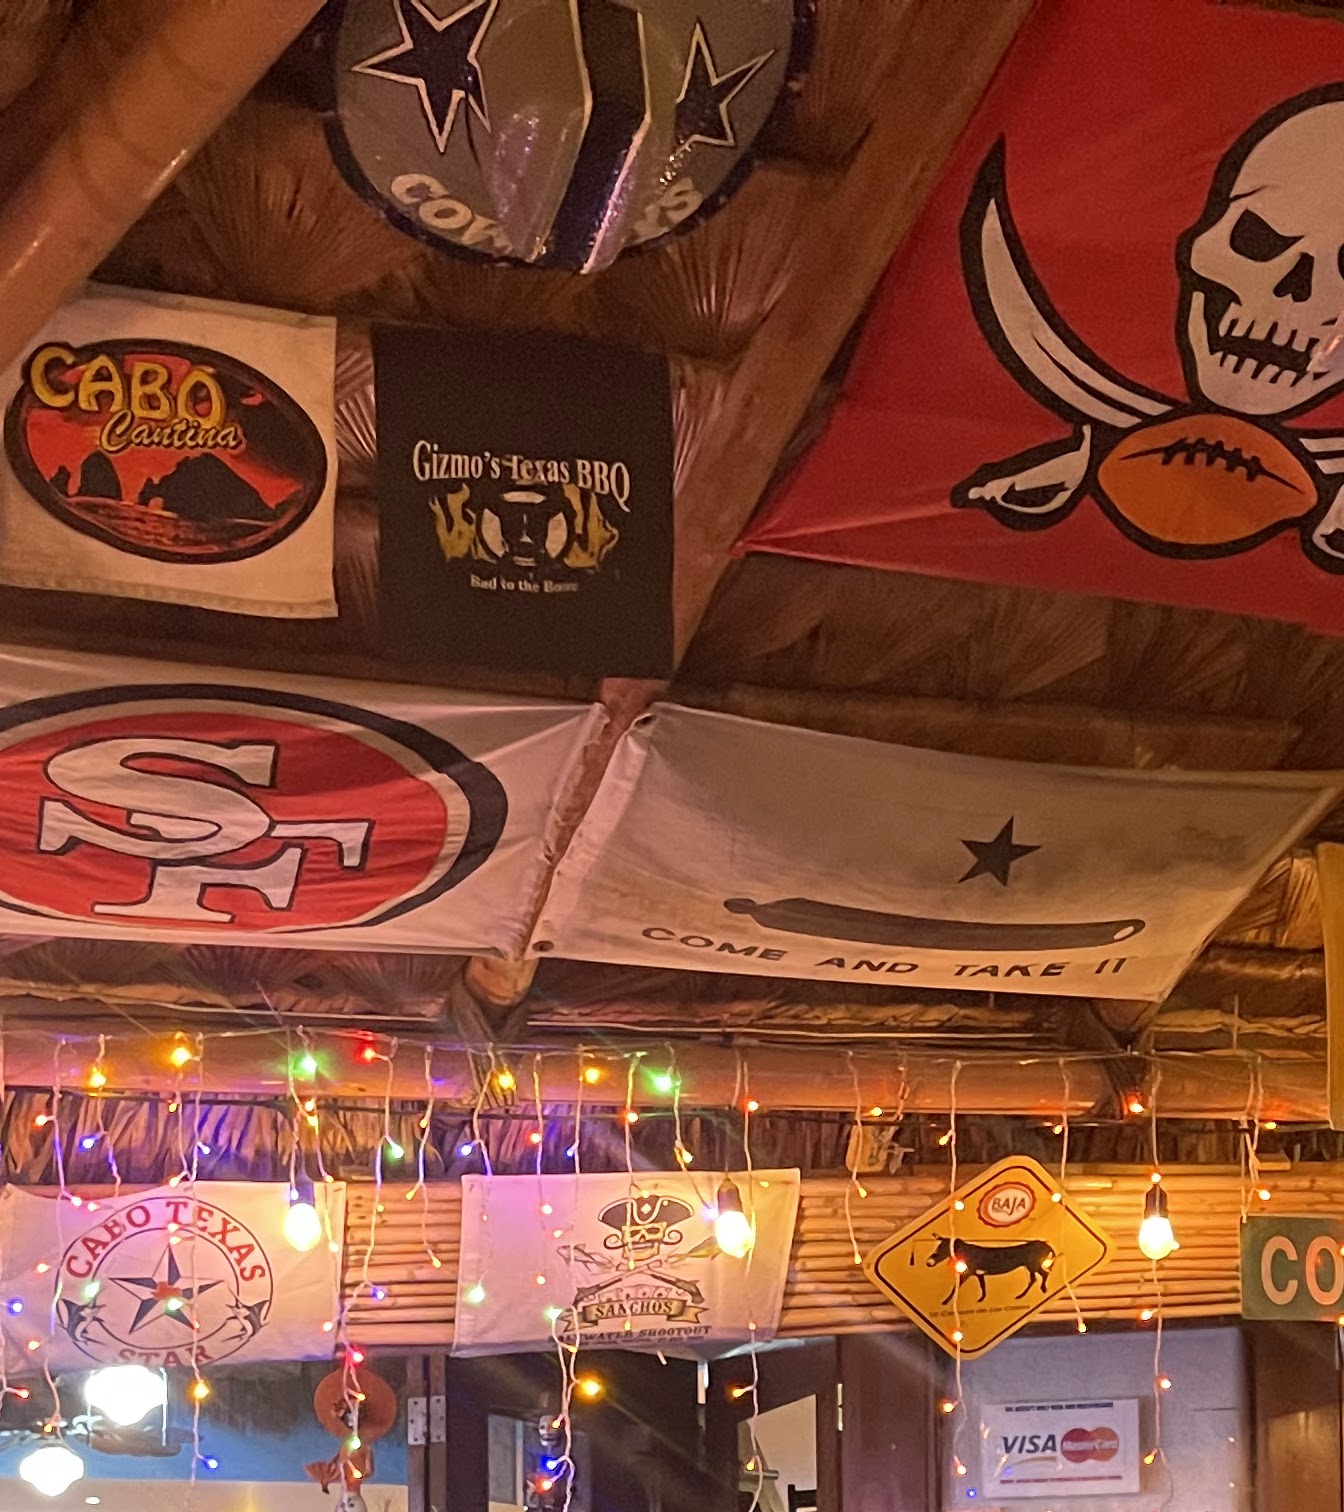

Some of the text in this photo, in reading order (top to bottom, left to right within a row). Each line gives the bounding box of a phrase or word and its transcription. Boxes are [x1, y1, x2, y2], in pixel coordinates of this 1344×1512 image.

[30, 345, 227, 429] CABO
[100, 408, 243, 454] Cantina
[413, 440, 631, 513] Gizmo's Texas BBQ
[470, 573, 497, 590] Bad
[518, 575, 540, 592] the
[641, 926, 1133, 980] COME AND TAKE IT
[991, 1197, 1027, 1216] BAJA
[65, 1200, 267, 1283] CABO TEXAS
[594, 1300, 674, 1320] SANCHOS
[638, 1325, 713, 1339] SHOOTOUT
[118, 1344, 214, 1367] STAR
[1001, 1433, 1057, 1454] VISA
